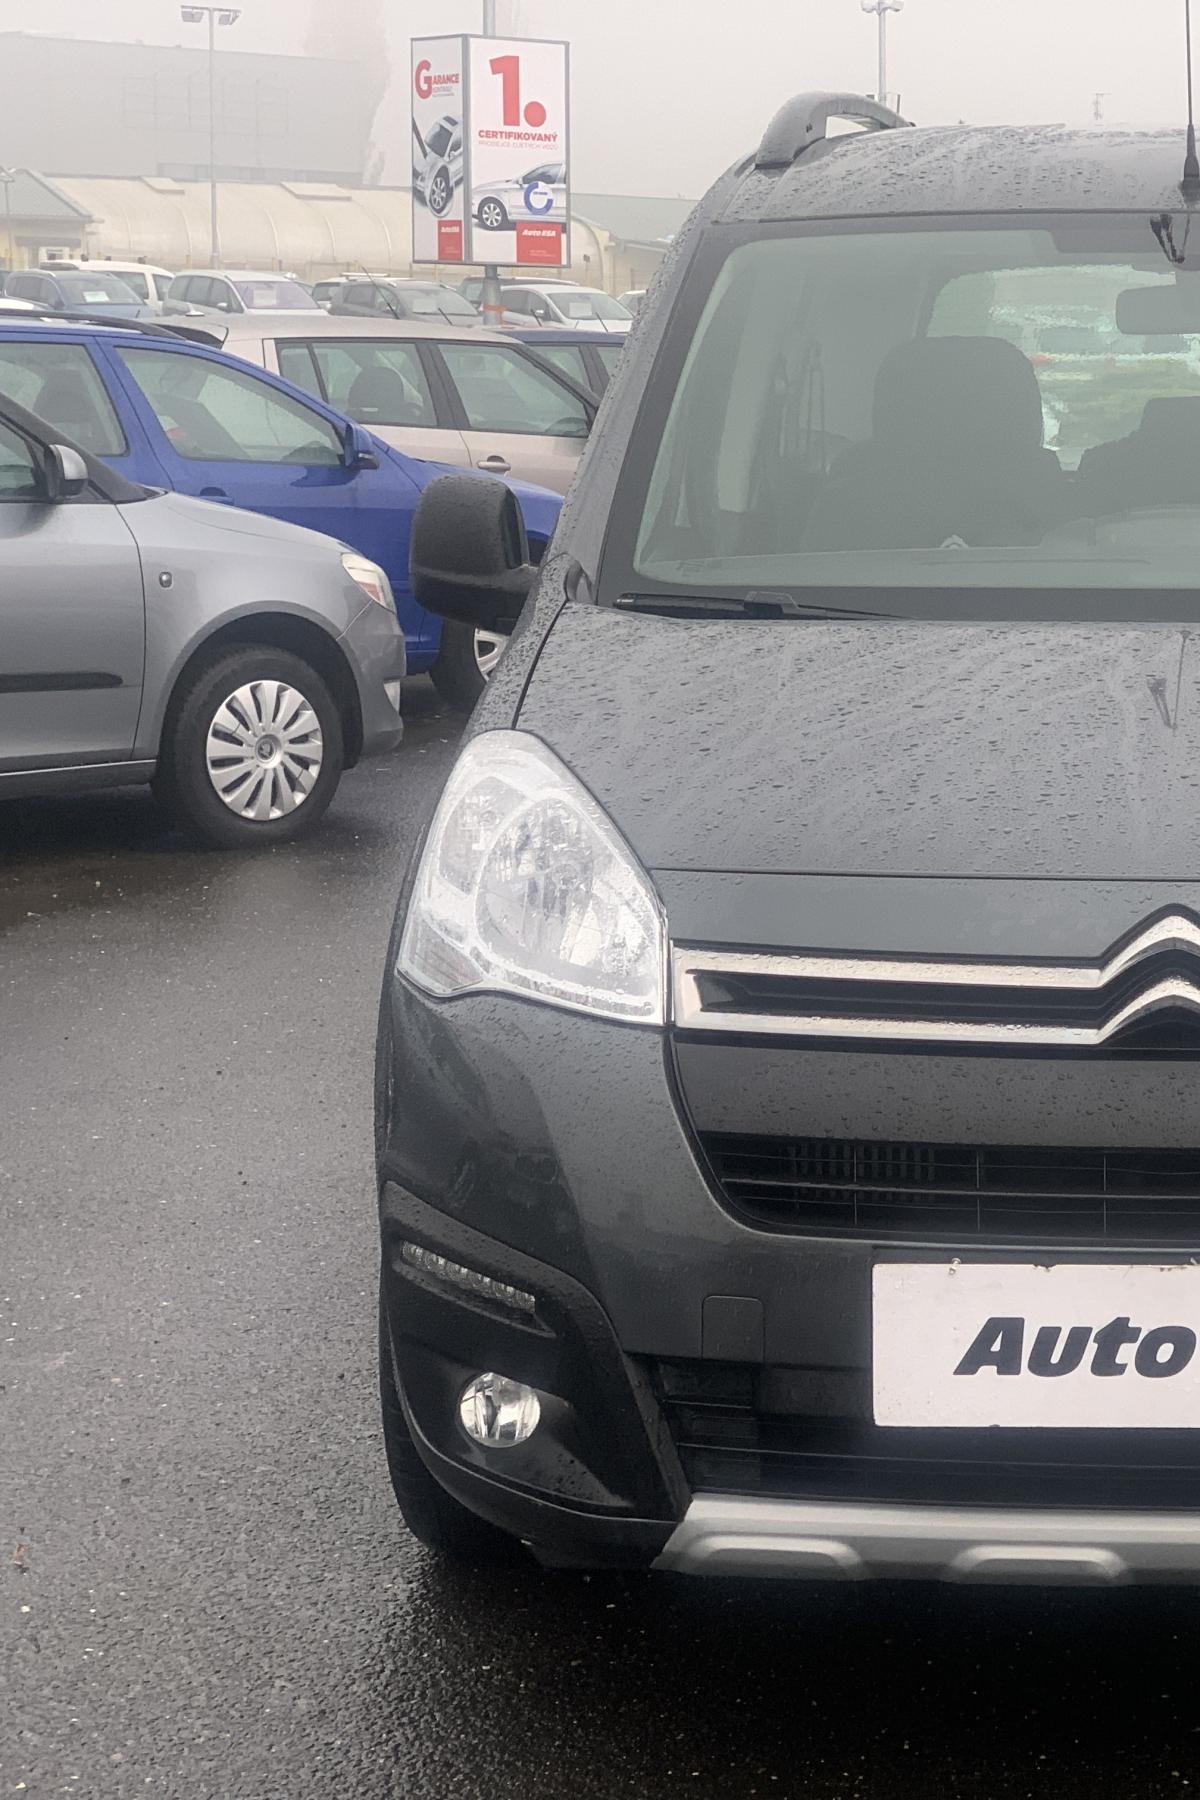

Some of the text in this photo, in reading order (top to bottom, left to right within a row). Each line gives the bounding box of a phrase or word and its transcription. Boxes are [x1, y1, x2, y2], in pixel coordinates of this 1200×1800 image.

[415, 59, 459, 100] GARANCE
[489, 55, 547, 127] 1.
[478, 129, 558, 143] CERTIFIKOVANÝ
[952, 1316, 1198, 1379] Auto
